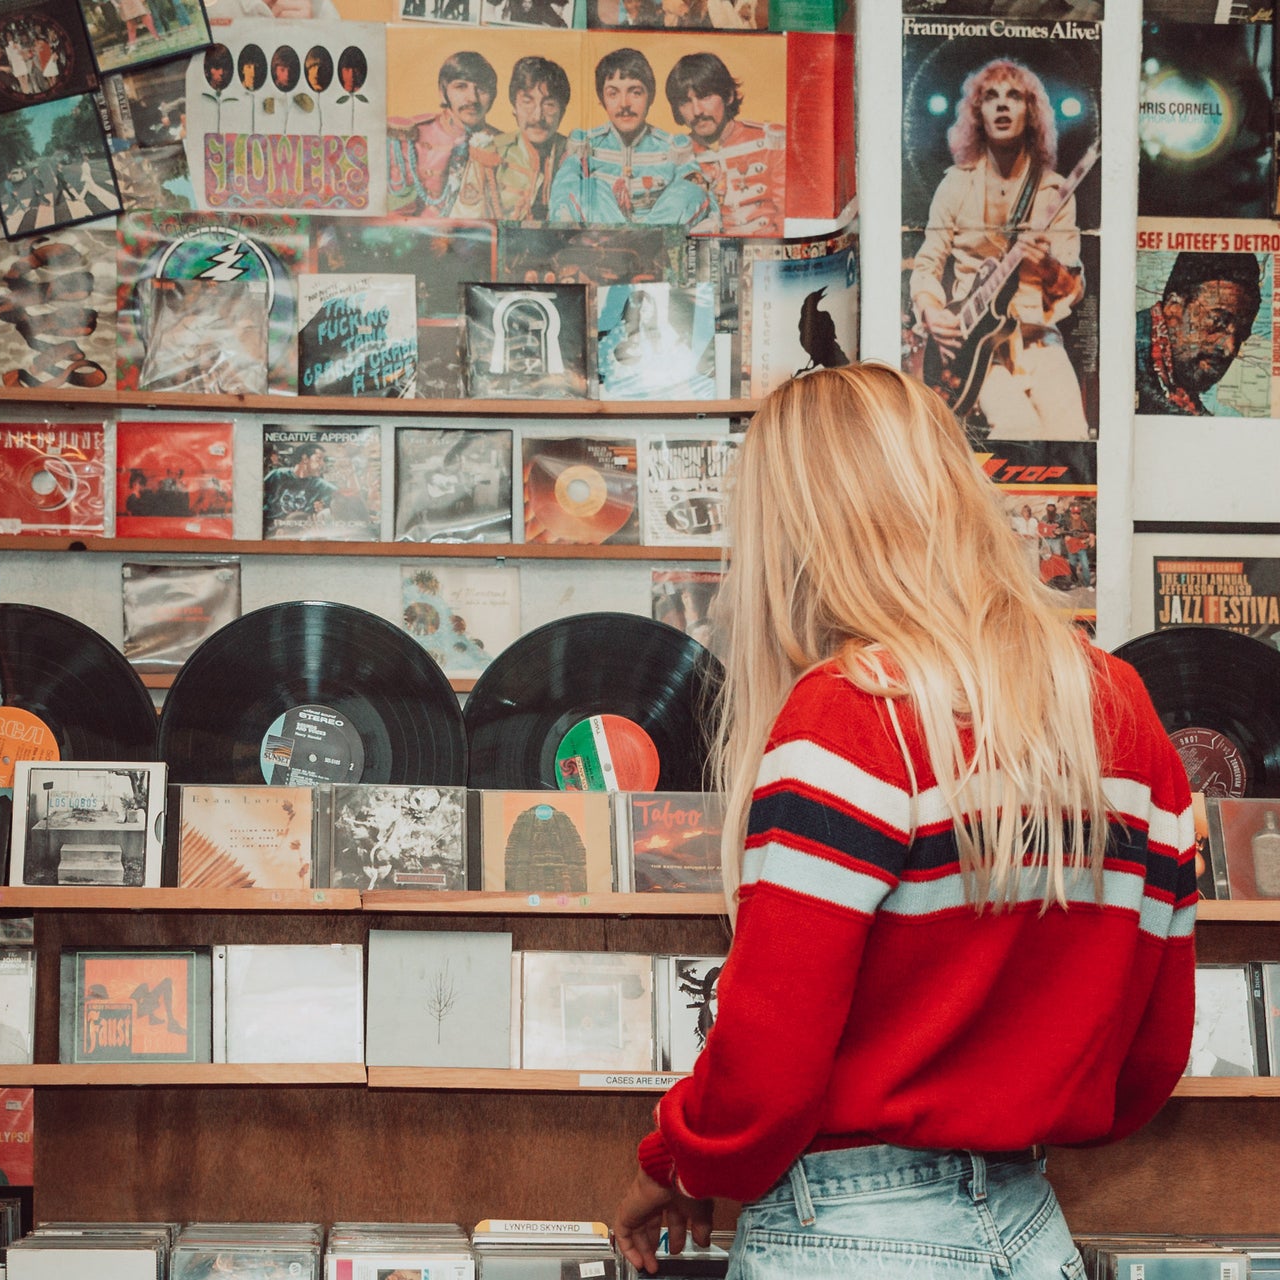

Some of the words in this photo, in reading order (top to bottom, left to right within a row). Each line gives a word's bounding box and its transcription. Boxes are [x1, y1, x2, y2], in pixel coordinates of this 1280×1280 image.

[902, 17, 987, 38] Frampton
[989, 20, 1048, 39] Comes
[1050, 21, 1101, 40] Alive!
[1169, 102, 1223, 116] CORNELL
[203, 134, 369, 195] FLOWERS
[1167, 232, 1230, 250] LATEEF'S
[265, 431, 318, 443] NEGATIVE
[1000, 465, 1069, 483] TOP
[1159, 573, 1179, 585] THE
[1180, 573, 1208, 586] FIFTH
[1209, 574, 1249, 586] ANNUAL
[1158, 585, 1216, 596] JEFFERSON
[1217, 585, 1253, 597] PARISH
[1158, 595, 1203, 624] JAZZ
[298, 711, 345, 727] STEREO
[263, 751, 291, 765] SUNSET
[349, 762, 355, 771] 2
[49, 797, 66, 809] LOS
[68, 798, 98, 809] LOBOS
[192, 794, 231, 807] Evan
[632, 800, 704, 828] Taboo
[2, 956, 23, 964] JOHN
[86, 1009, 132, 1054] Faust
[605, 1076, 634, 1085] CASES
[635, 1076, 653, 1085] ARE
[504, 1223, 539, 1232] LYNYRD
[539, 1223, 581, 1233] SKYNYRD
